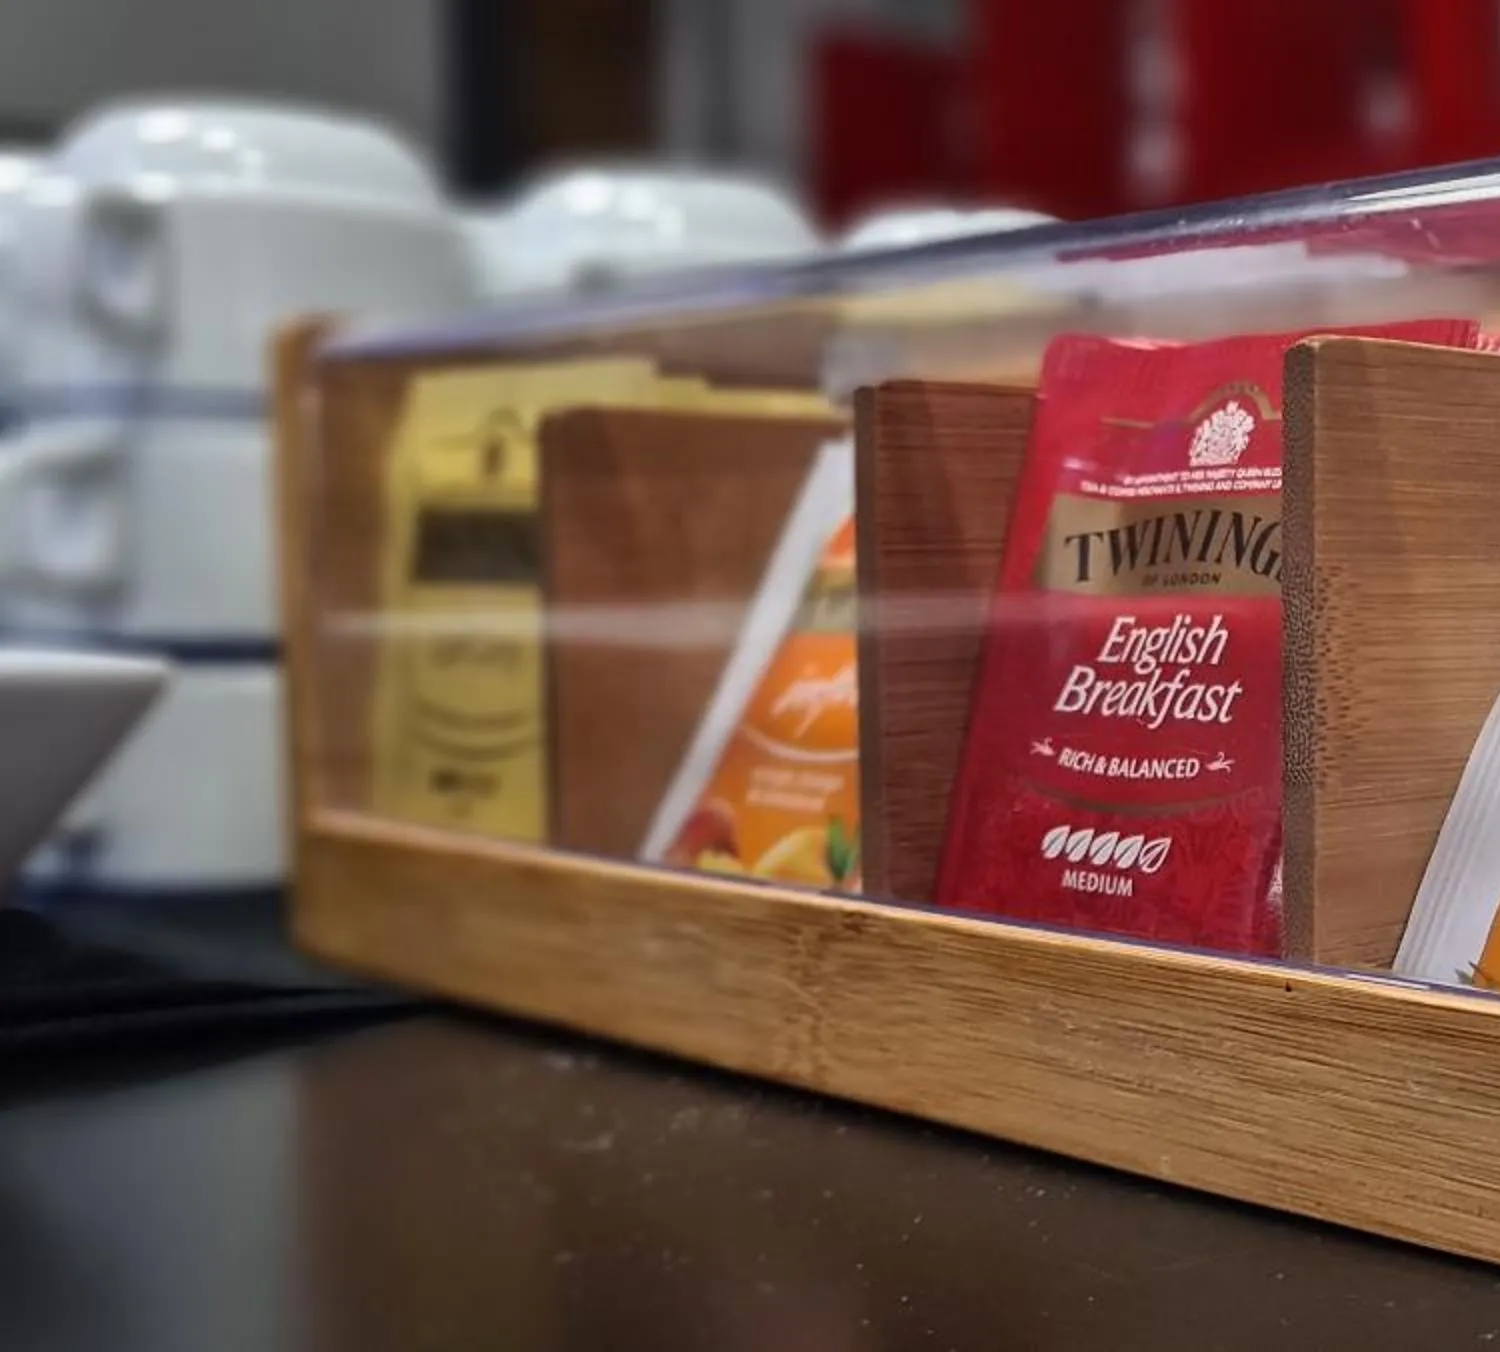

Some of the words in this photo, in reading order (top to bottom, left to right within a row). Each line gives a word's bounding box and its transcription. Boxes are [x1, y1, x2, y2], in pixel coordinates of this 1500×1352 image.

[1065, 509, 1283, 583] TWINING
[1163, 571, 1222, 586] LONDON
[1097, 613, 1228, 675] English
[1053, 665, 1242, 729] Breakfast
[1059, 747, 1093, 775] RICH
[1094, 758, 1106, 774] &
[1107, 757, 1200, 779] BALANCED
[1061, 869, 1133, 897] MEDIUM
